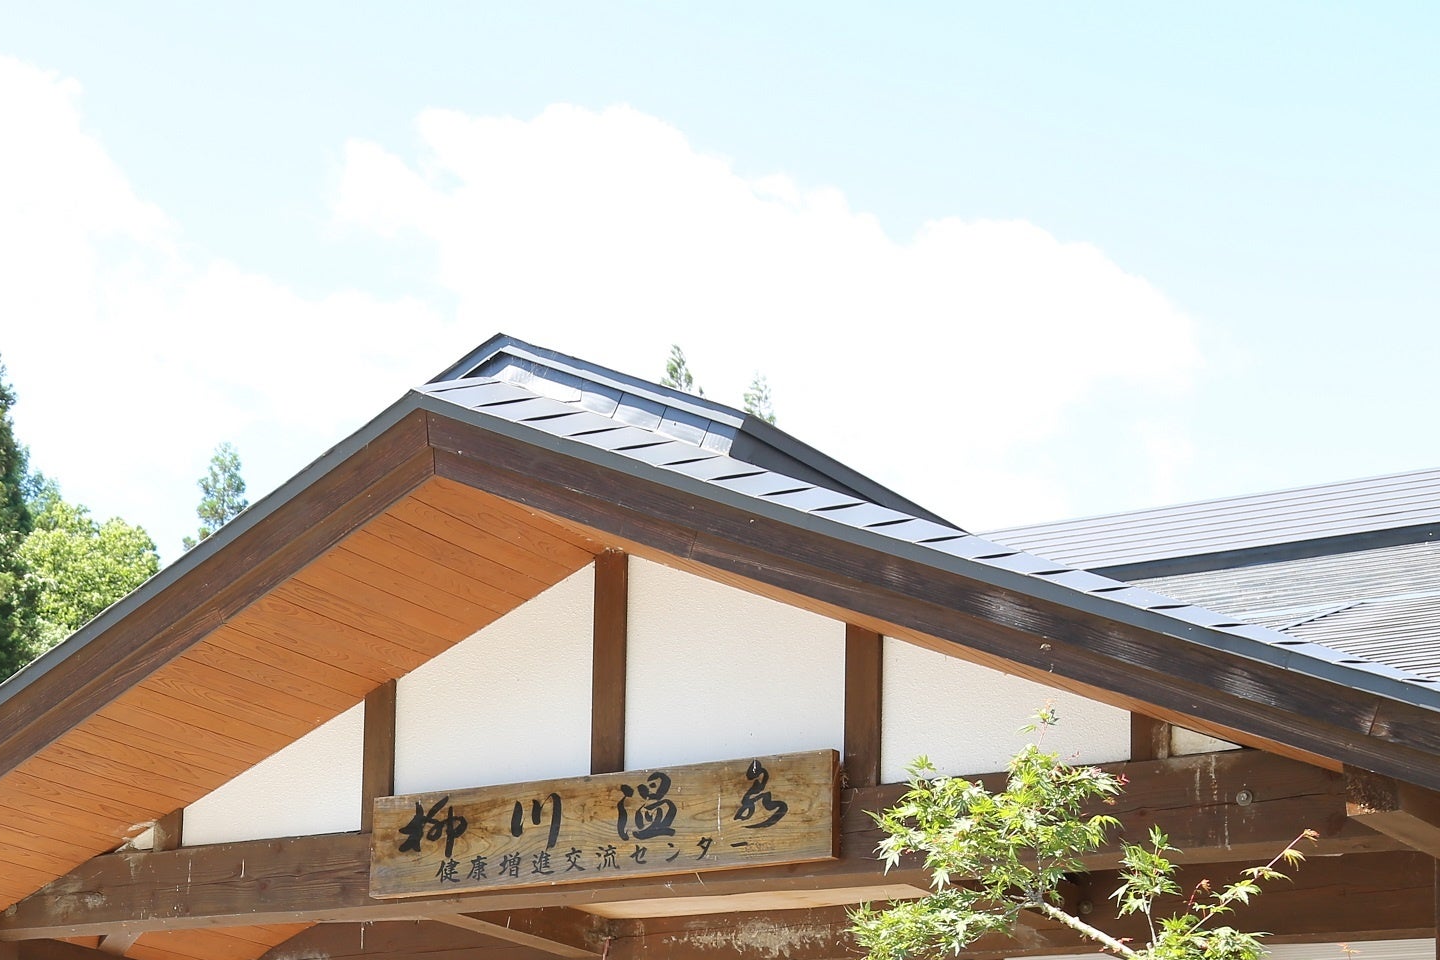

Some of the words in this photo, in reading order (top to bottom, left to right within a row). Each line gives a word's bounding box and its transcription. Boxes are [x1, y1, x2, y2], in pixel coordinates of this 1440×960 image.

[398, 759, 789, 858] 柳川温泉
[435, 835, 748, 884] 健康増進交流センター
